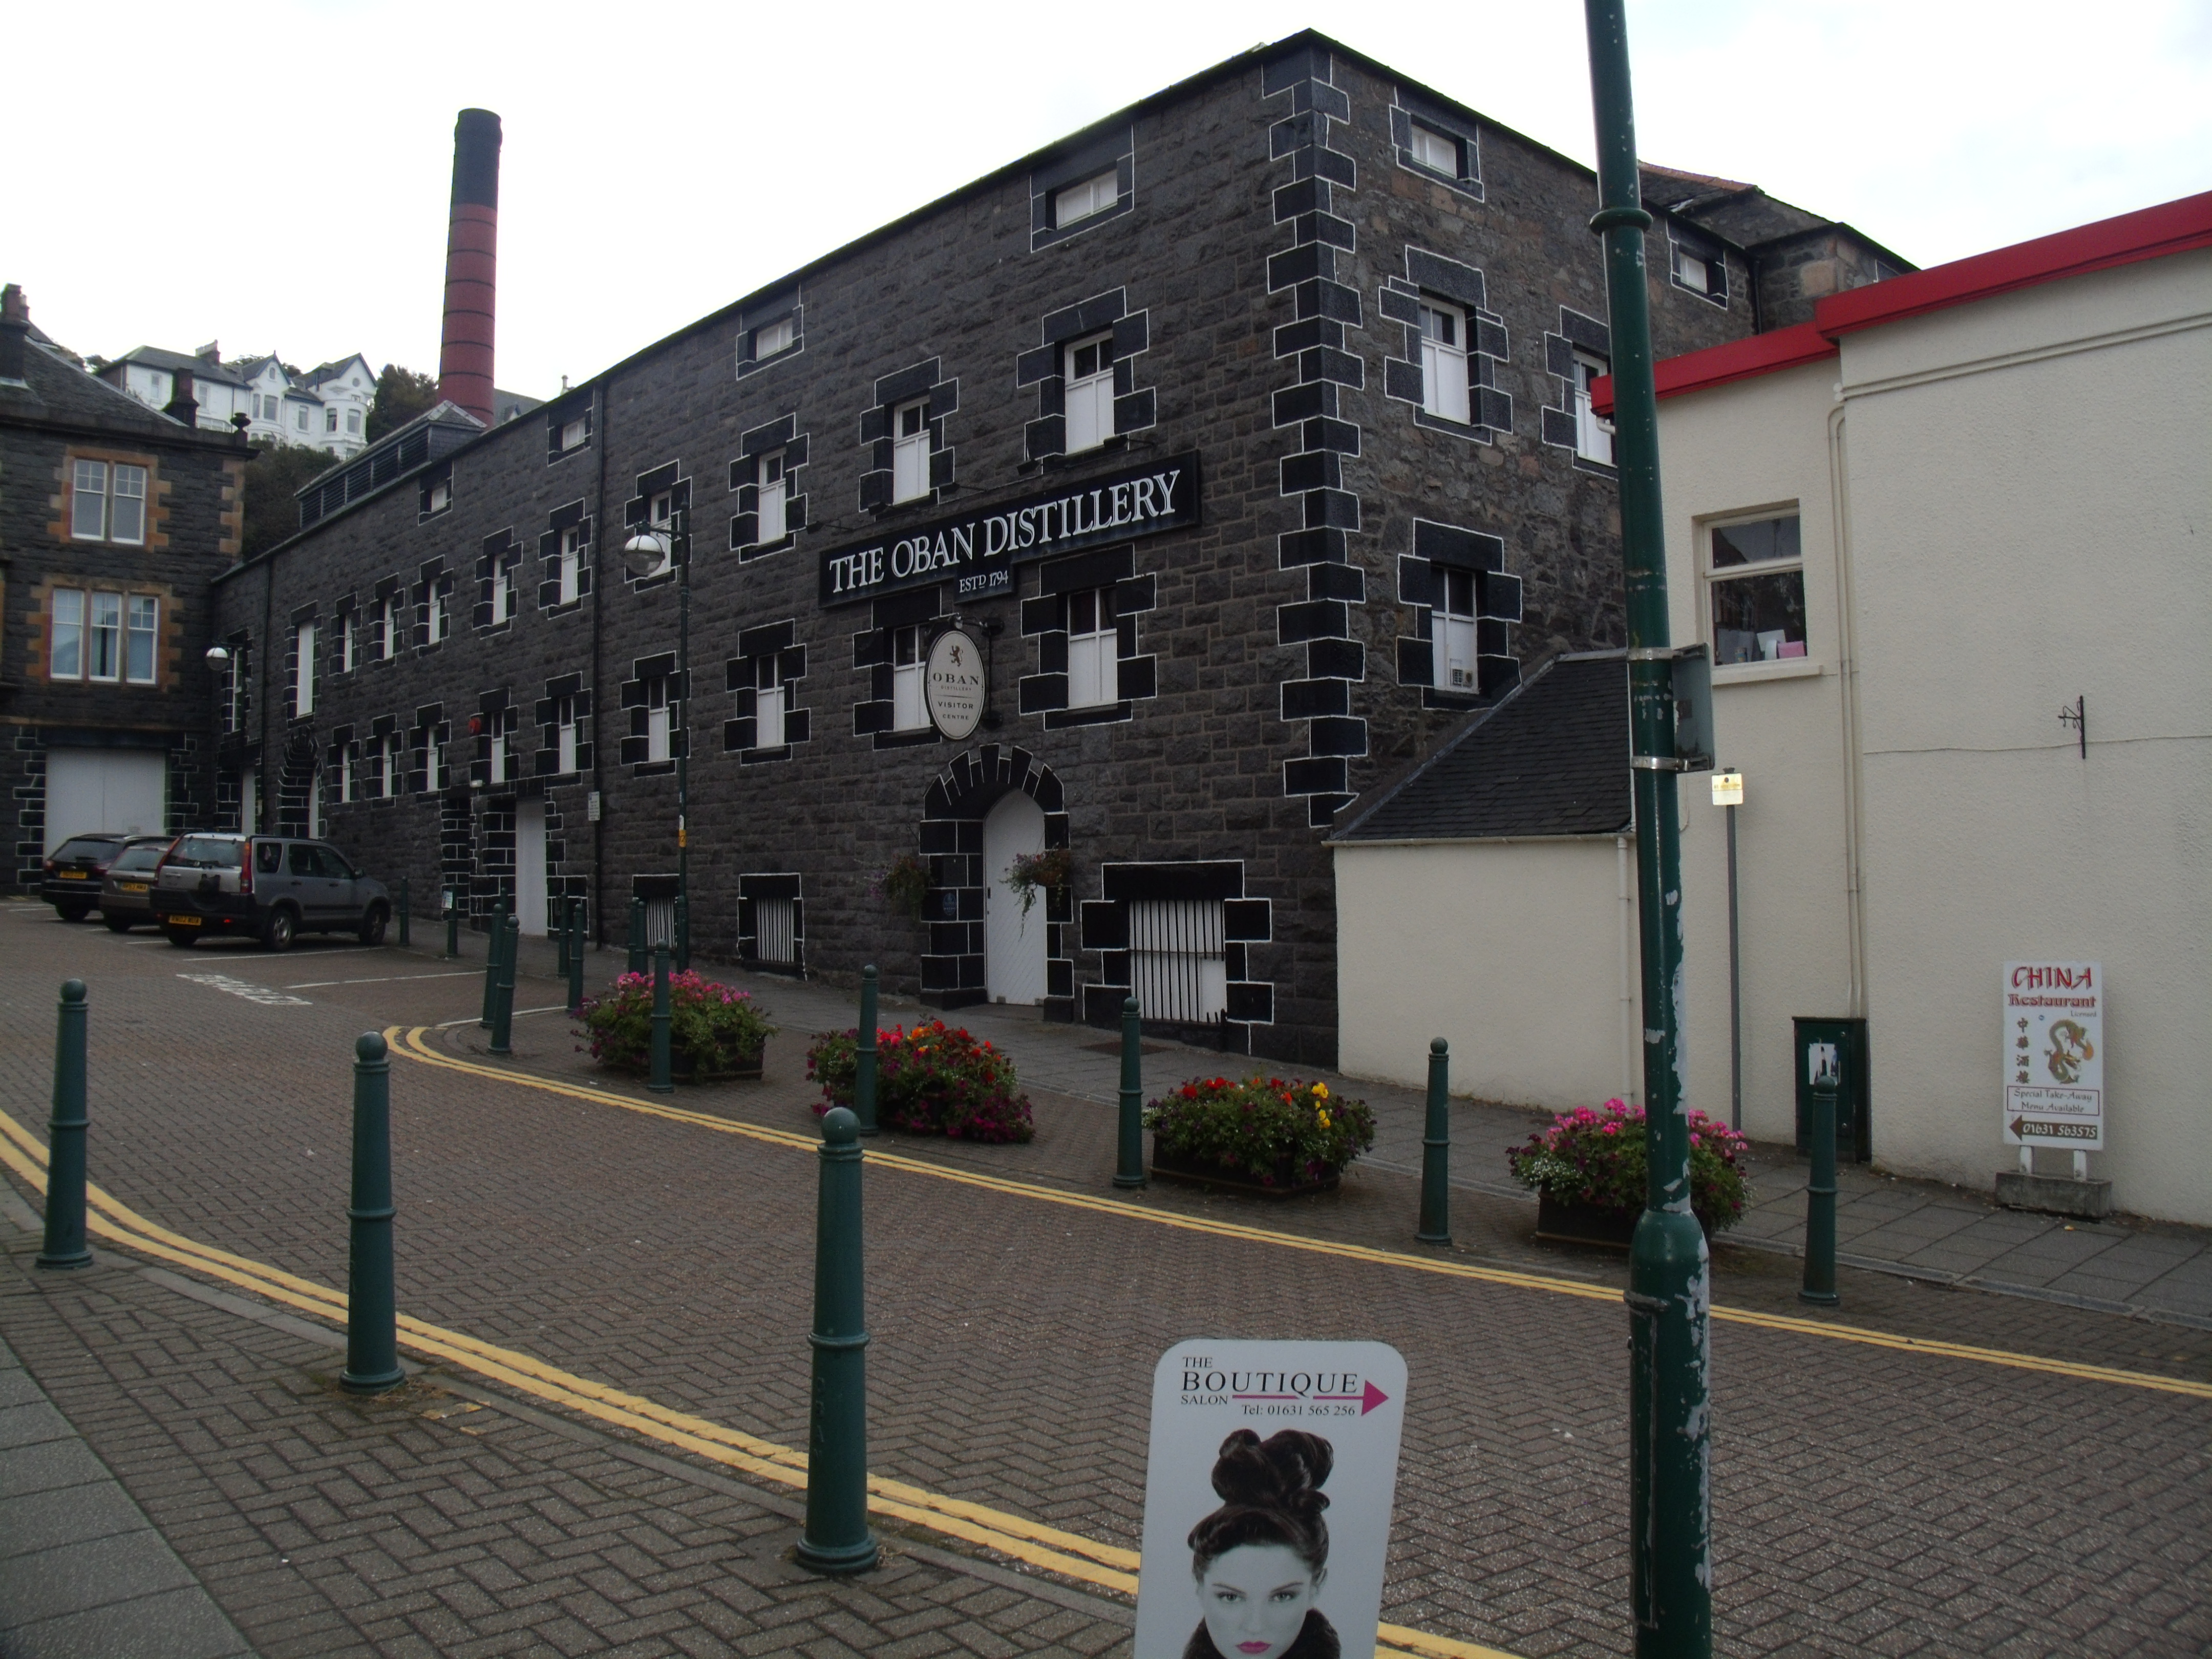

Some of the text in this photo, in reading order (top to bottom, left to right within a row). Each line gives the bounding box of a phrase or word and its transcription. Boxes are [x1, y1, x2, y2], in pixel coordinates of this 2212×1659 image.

[830, 469, 1181, 593] THE OBAN DISTILLERY
[959, 570, 1009, 593] ESTD 1794
[933, 673, 979, 685] OBAN
[2012, 966, 2092, 990] CHINA
[2008, 993, 2096, 1008] Restaurant
[2014, 1089, 2092, 1102] Special Take-Away
[2021, 1101, 2085, 1113] Menu Available
[2023, 1123, 2097, 1138] 01631 563575
[1182, 1357, 1213, 1368] THE
[1181, 1371, 1358, 1398] BOUTIQUE
[1181, 1395, 1228, 1405] SALON
[1242, 1405, 1355, 1416] Tel: 01631 565 256
